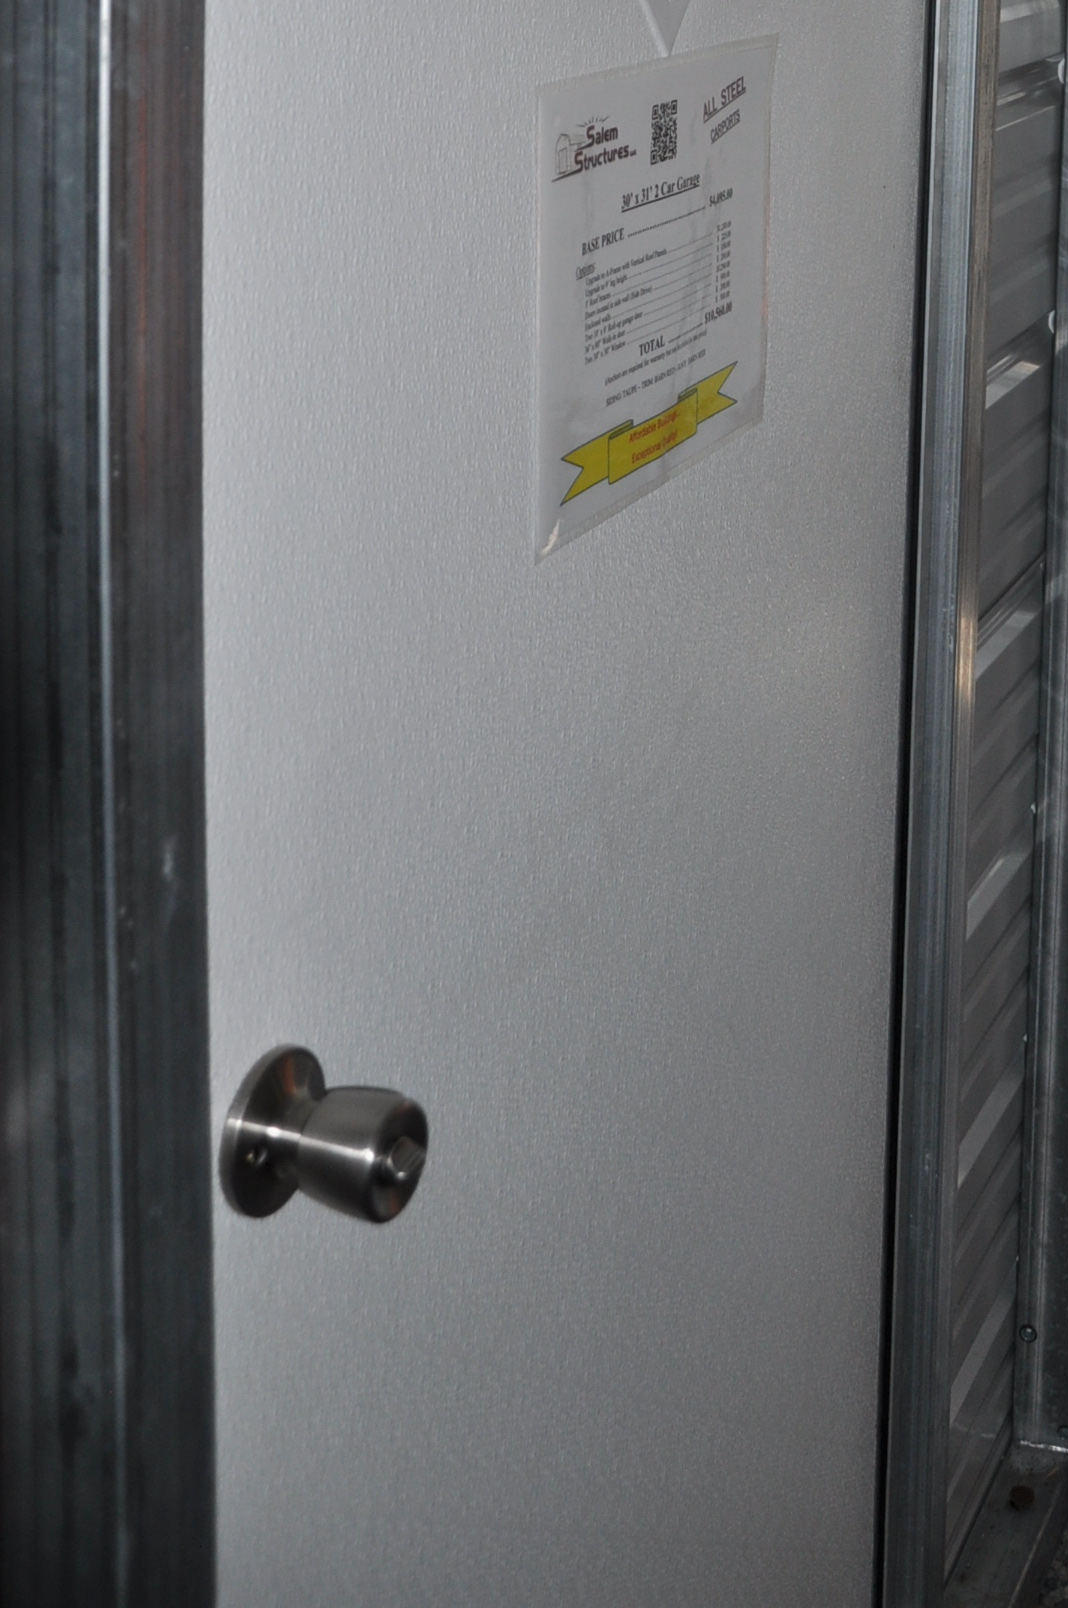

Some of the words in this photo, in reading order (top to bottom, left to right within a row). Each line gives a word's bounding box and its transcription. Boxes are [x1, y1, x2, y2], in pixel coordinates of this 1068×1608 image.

[703, 96, 718, 118] ALL
[720, 76, 746, 104] STEEL
[585, 125, 618, 147] Salem
[710, 109, 741, 140] CARPORTS
[574, 144, 630, 172] Structures
[635, 194, 639, 204] x
[654, 184, 659, 198] 2
[661, 181, 675, 195] Car
[676, 174, 700, 193] Garage
[582, 237, 599, 256] BASE
[601, 228, 624, 247] PRICE
[639, 335, 665, 356] TOTAL
[629, 423, 656, 442] Affordable
